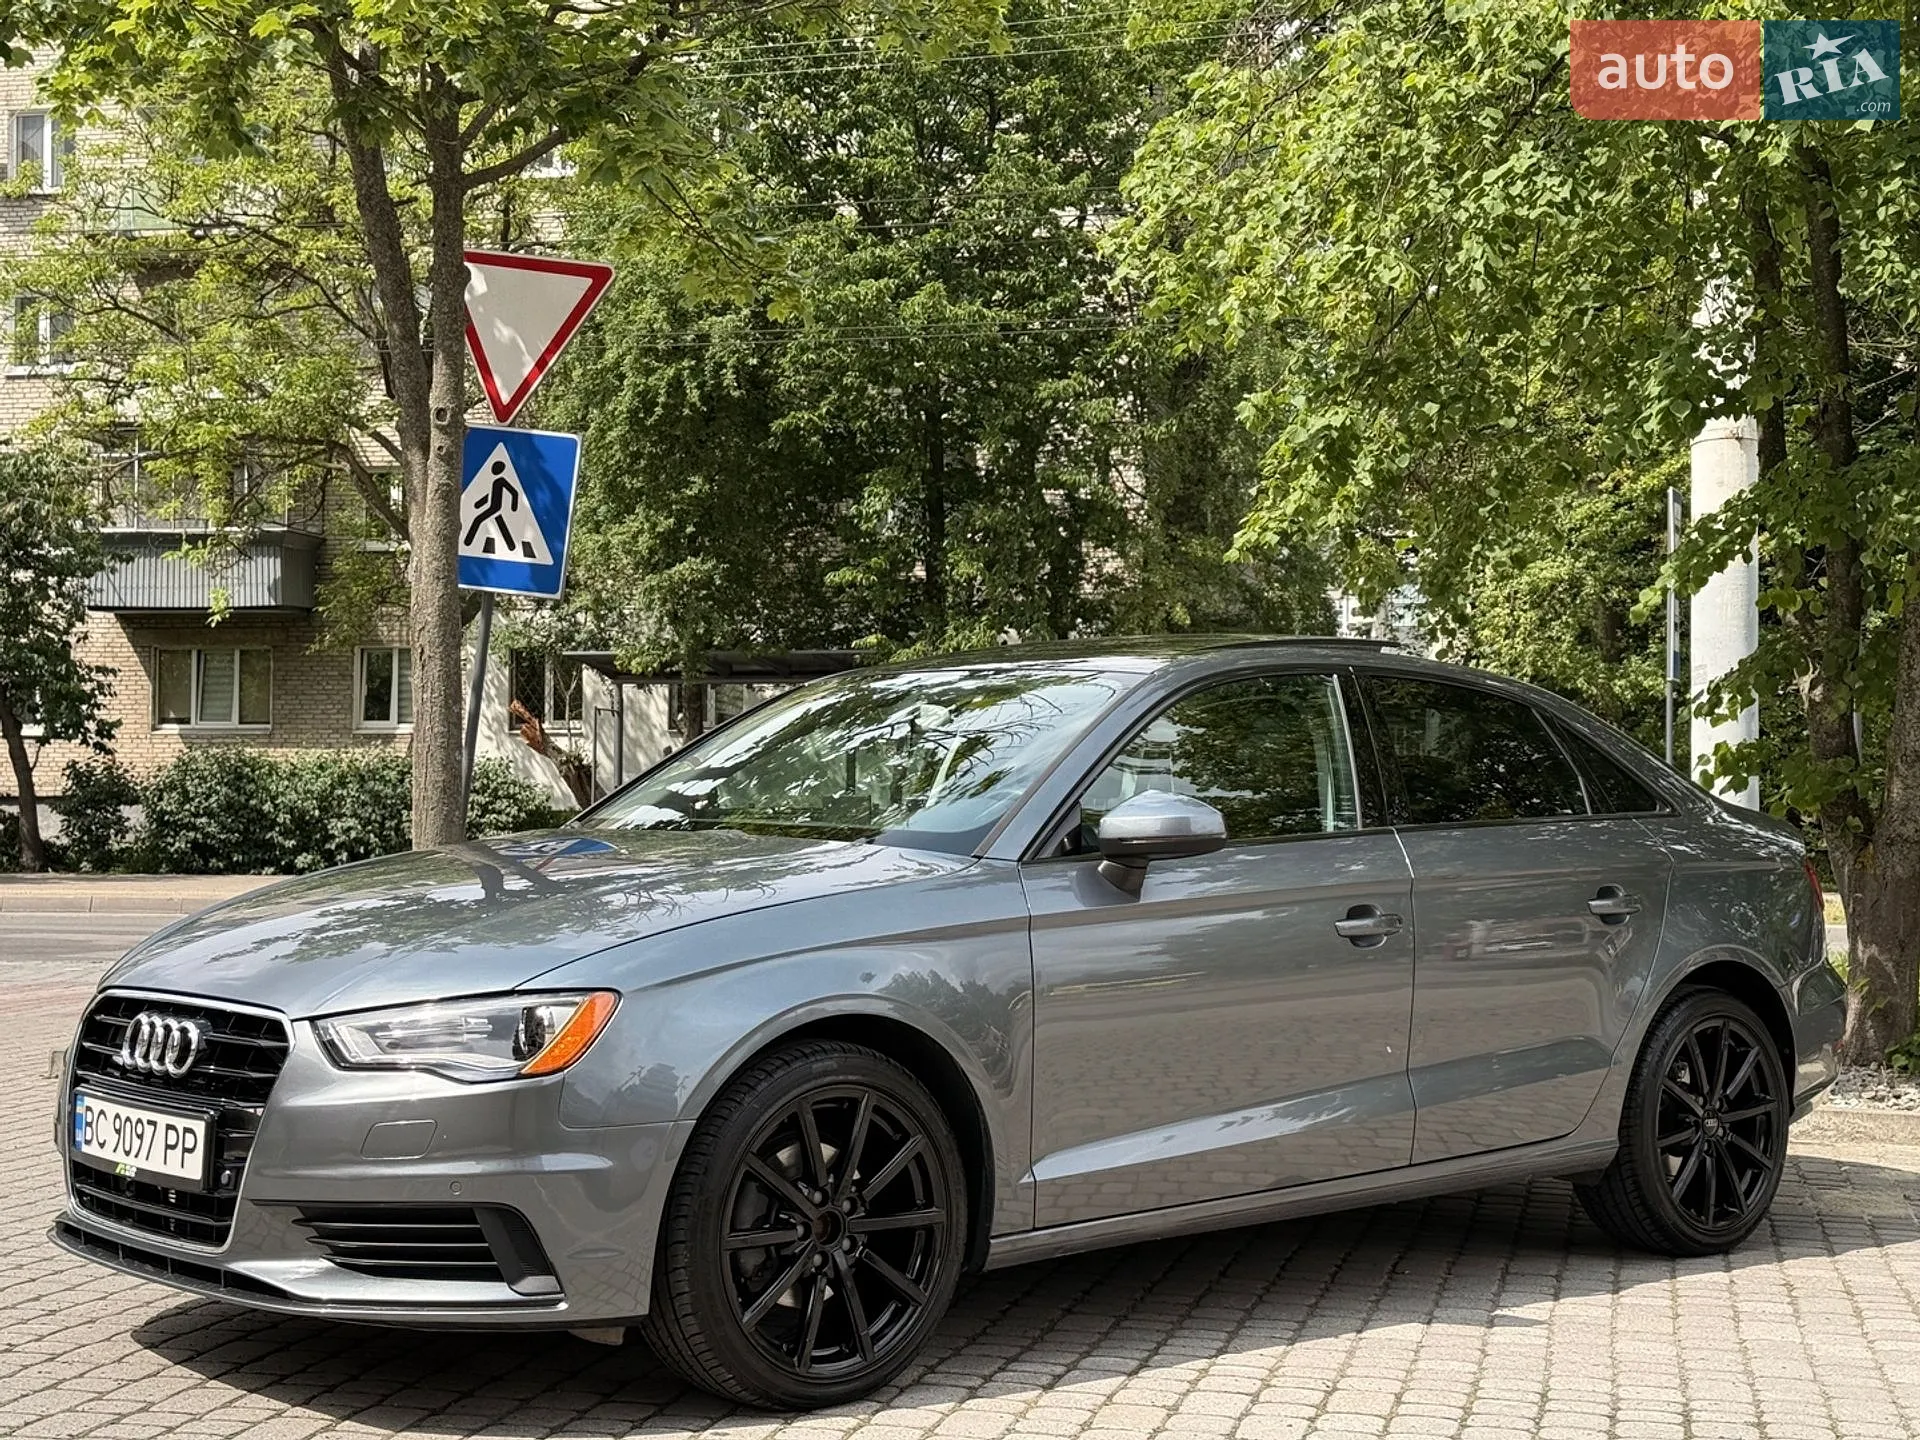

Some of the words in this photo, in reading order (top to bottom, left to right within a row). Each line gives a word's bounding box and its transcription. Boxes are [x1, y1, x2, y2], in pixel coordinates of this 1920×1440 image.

[84, 1105, 108, 1150] BC
[113, 1112, 158, 1162] 9097
[163, 1123, 198, 1169] PP
